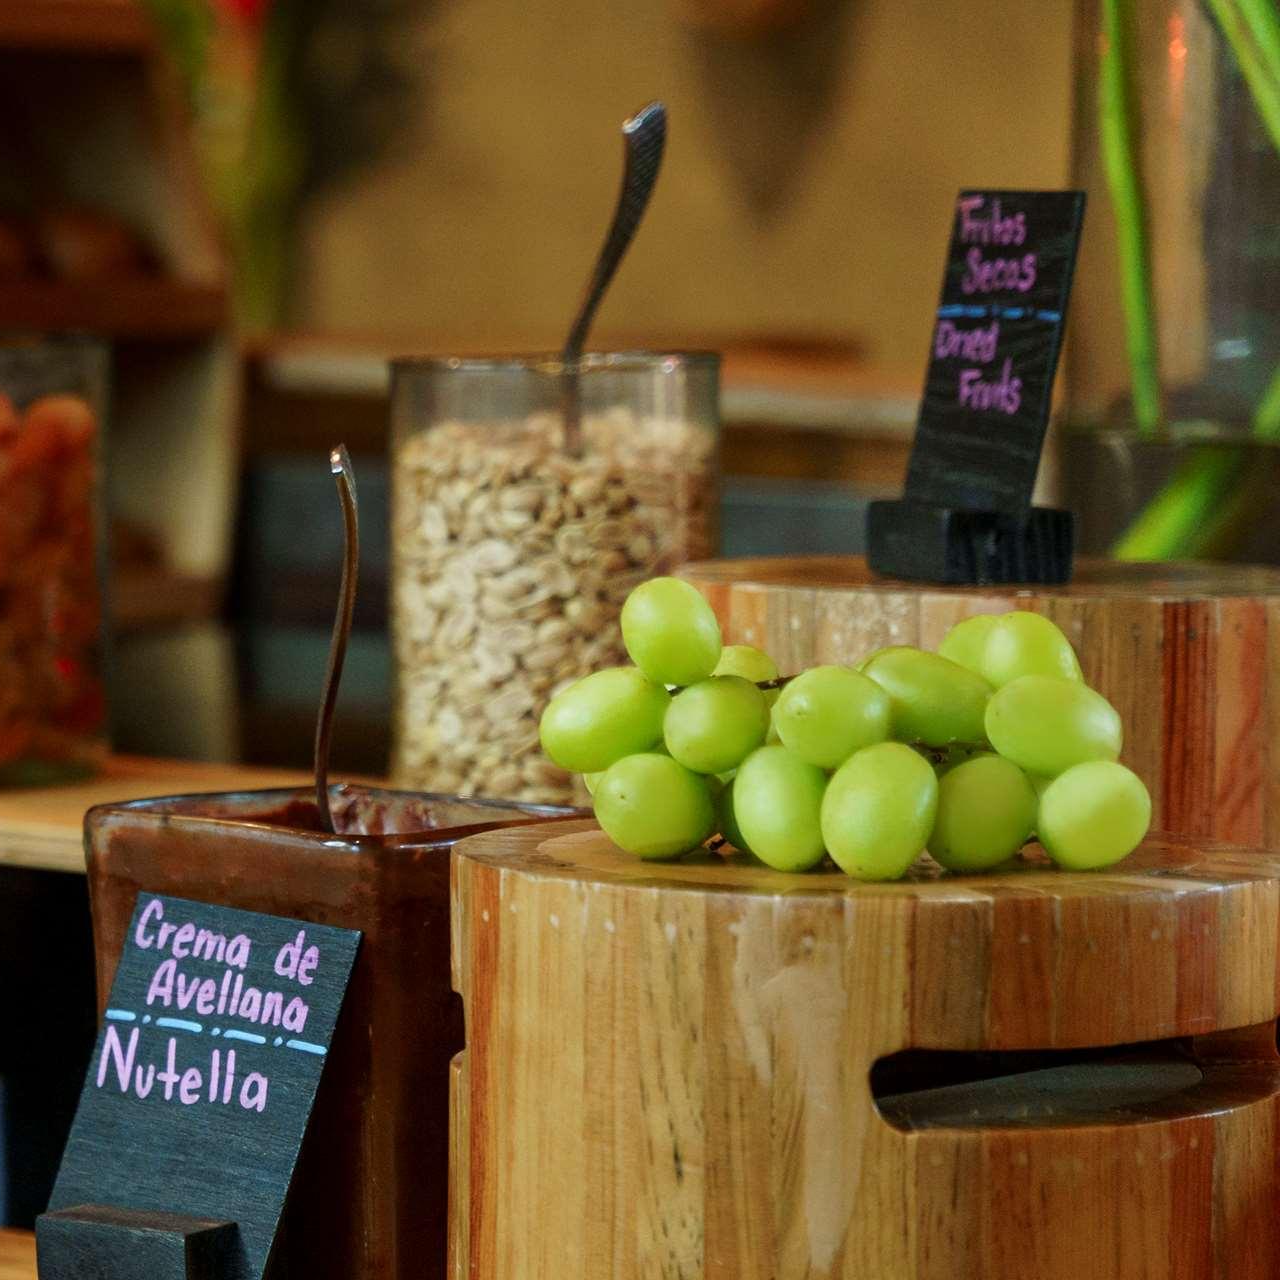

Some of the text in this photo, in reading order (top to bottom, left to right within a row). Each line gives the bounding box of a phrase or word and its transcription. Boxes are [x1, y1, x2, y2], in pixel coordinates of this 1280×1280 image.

[135, 899, 320, 986] Crema de
[146, 959, 308, 1033] Avellana
[96, 1025, 268, 1112] Nutella
